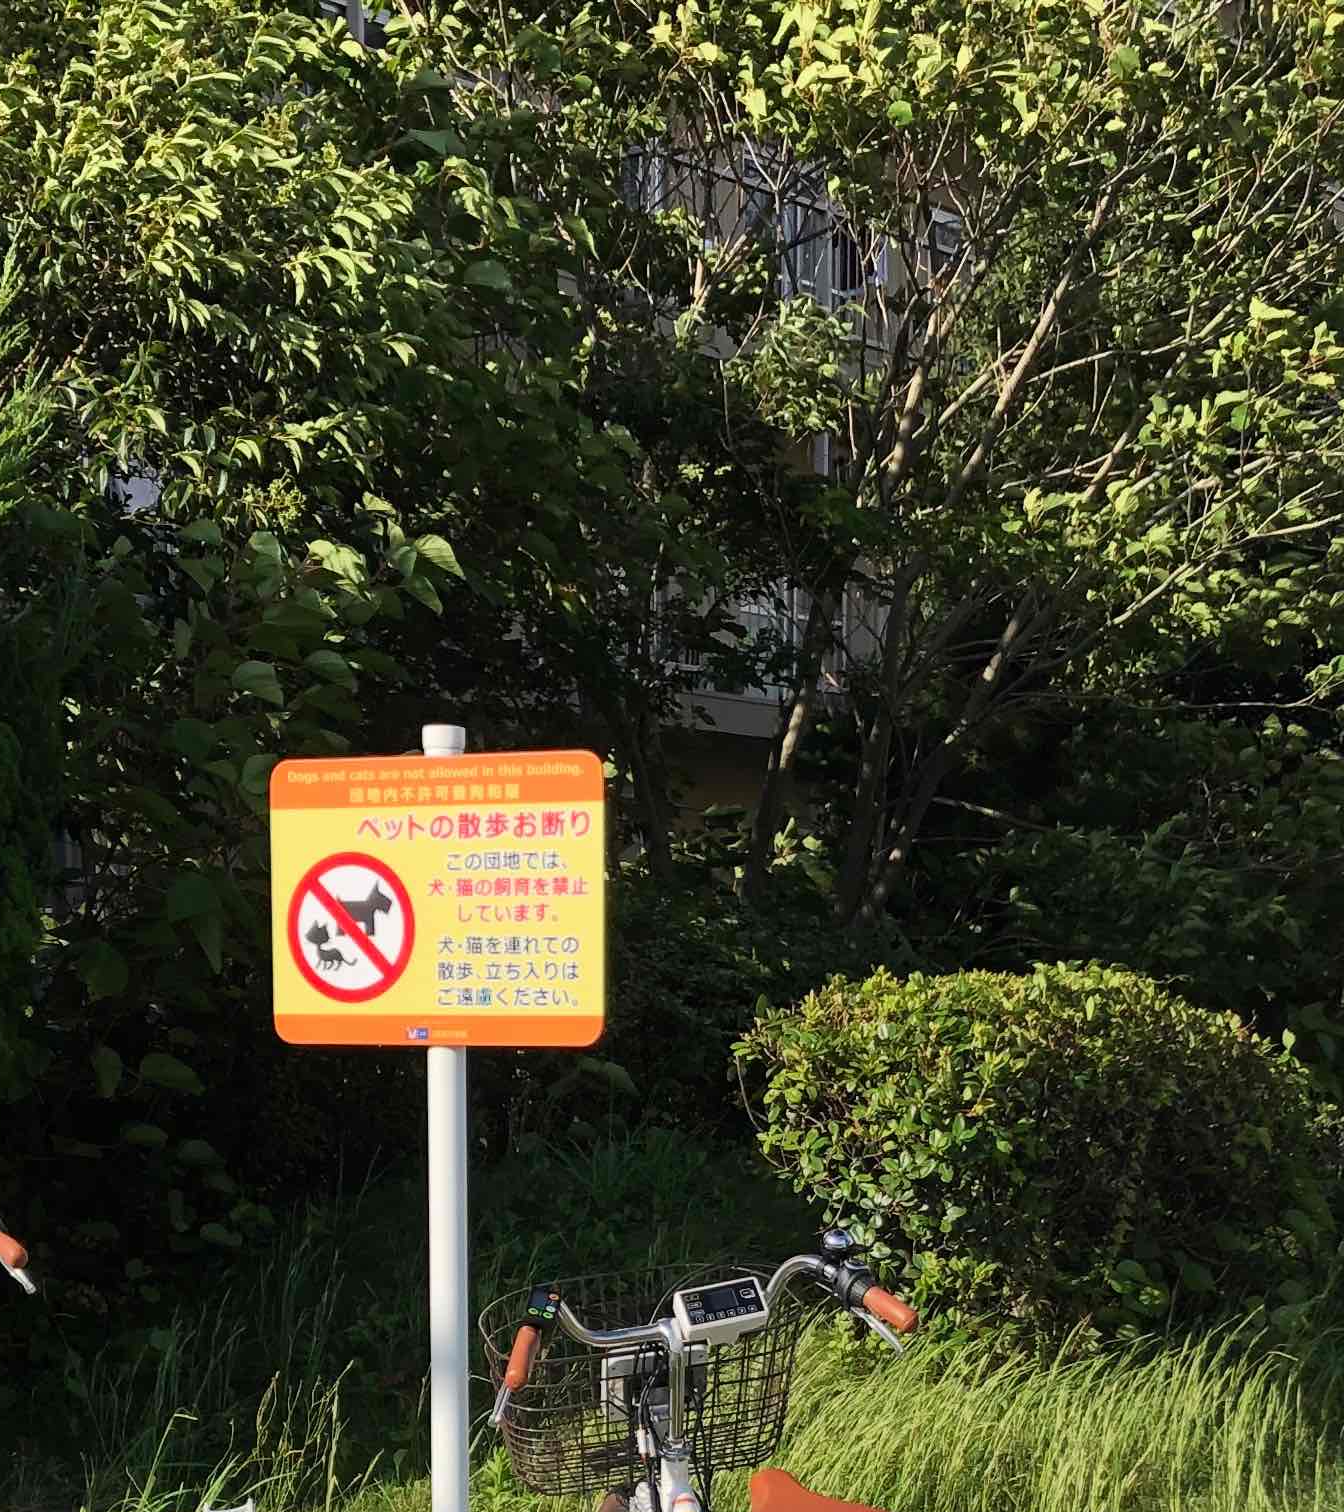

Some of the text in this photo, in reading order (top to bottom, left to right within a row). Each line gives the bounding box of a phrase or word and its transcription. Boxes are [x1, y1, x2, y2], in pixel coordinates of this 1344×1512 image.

[287, 771, 320, 784] Dogs
[323, 770, 348, 781] and
[350, 769, 374, 781] cats
[378, 770, 400, 780] are
[403, 767, 425, 779] not
[429, 765, 479, 779] allowed
[483, 766, 495, 777] in
[497, 764, 524, 777] this
[357, 810, 592, 841] ペットの散歩お断り
[446, 851, 569, 871] この団地では、
[427, 877, 589, 897] 犬・猫の飼育を禁止
[457, 903, 558, 923] しています。
[437, 936, 580, 954] 犬・猫を連れての
[437, 961, 580, 981] 散歩、立ち入りは
[437, 987, 579, 1007] ご遠慮ください。
